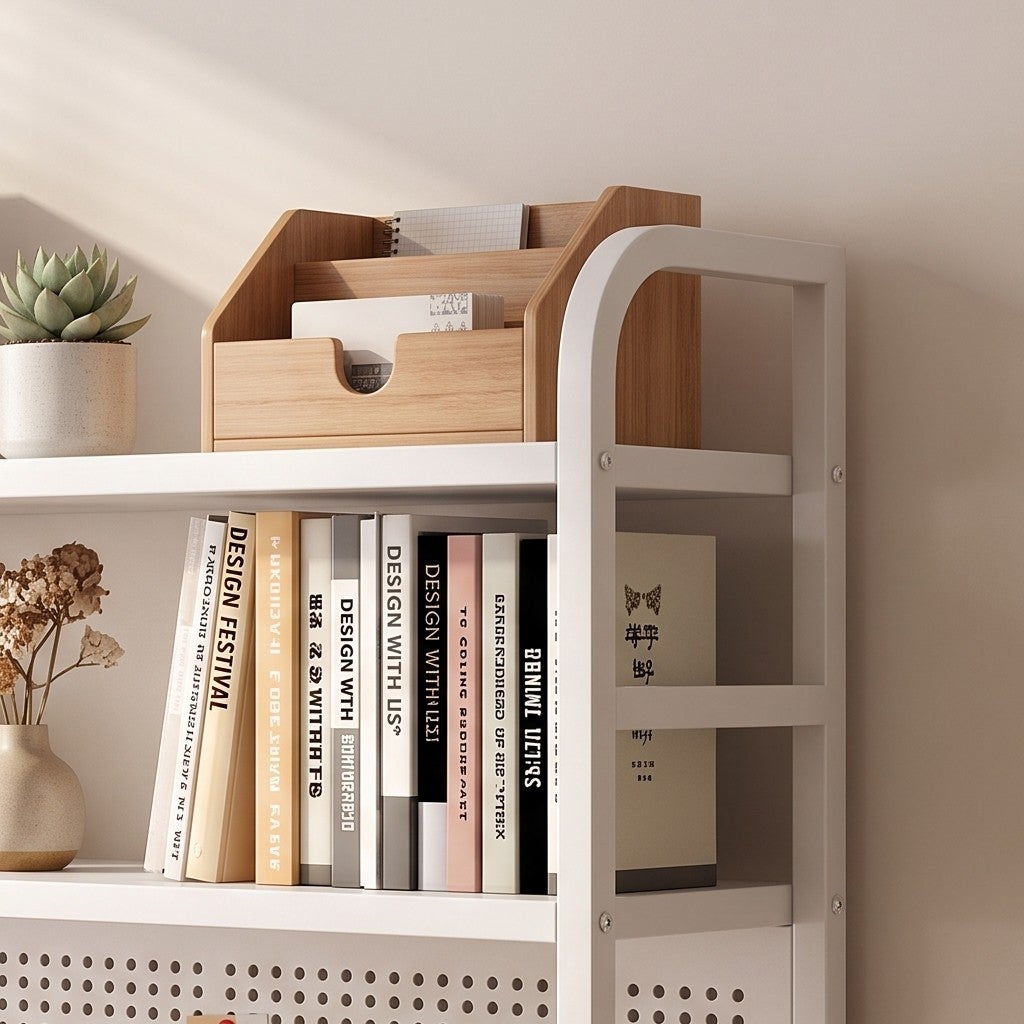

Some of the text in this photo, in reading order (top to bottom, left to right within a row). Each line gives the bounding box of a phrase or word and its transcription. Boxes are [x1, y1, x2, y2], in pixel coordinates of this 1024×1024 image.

[209, 526, 248, 711] DESIGN FESTIVAL
[386, 545, 402, 628] DESIGN
[425, 564, 441, 641] DESIGN
[340, 598, 354, 673] DESIGN
[386, 634, 402, 690] WITH
[340, 677, 354, 721] WTH
[425, 649, 441, 699] WITH
